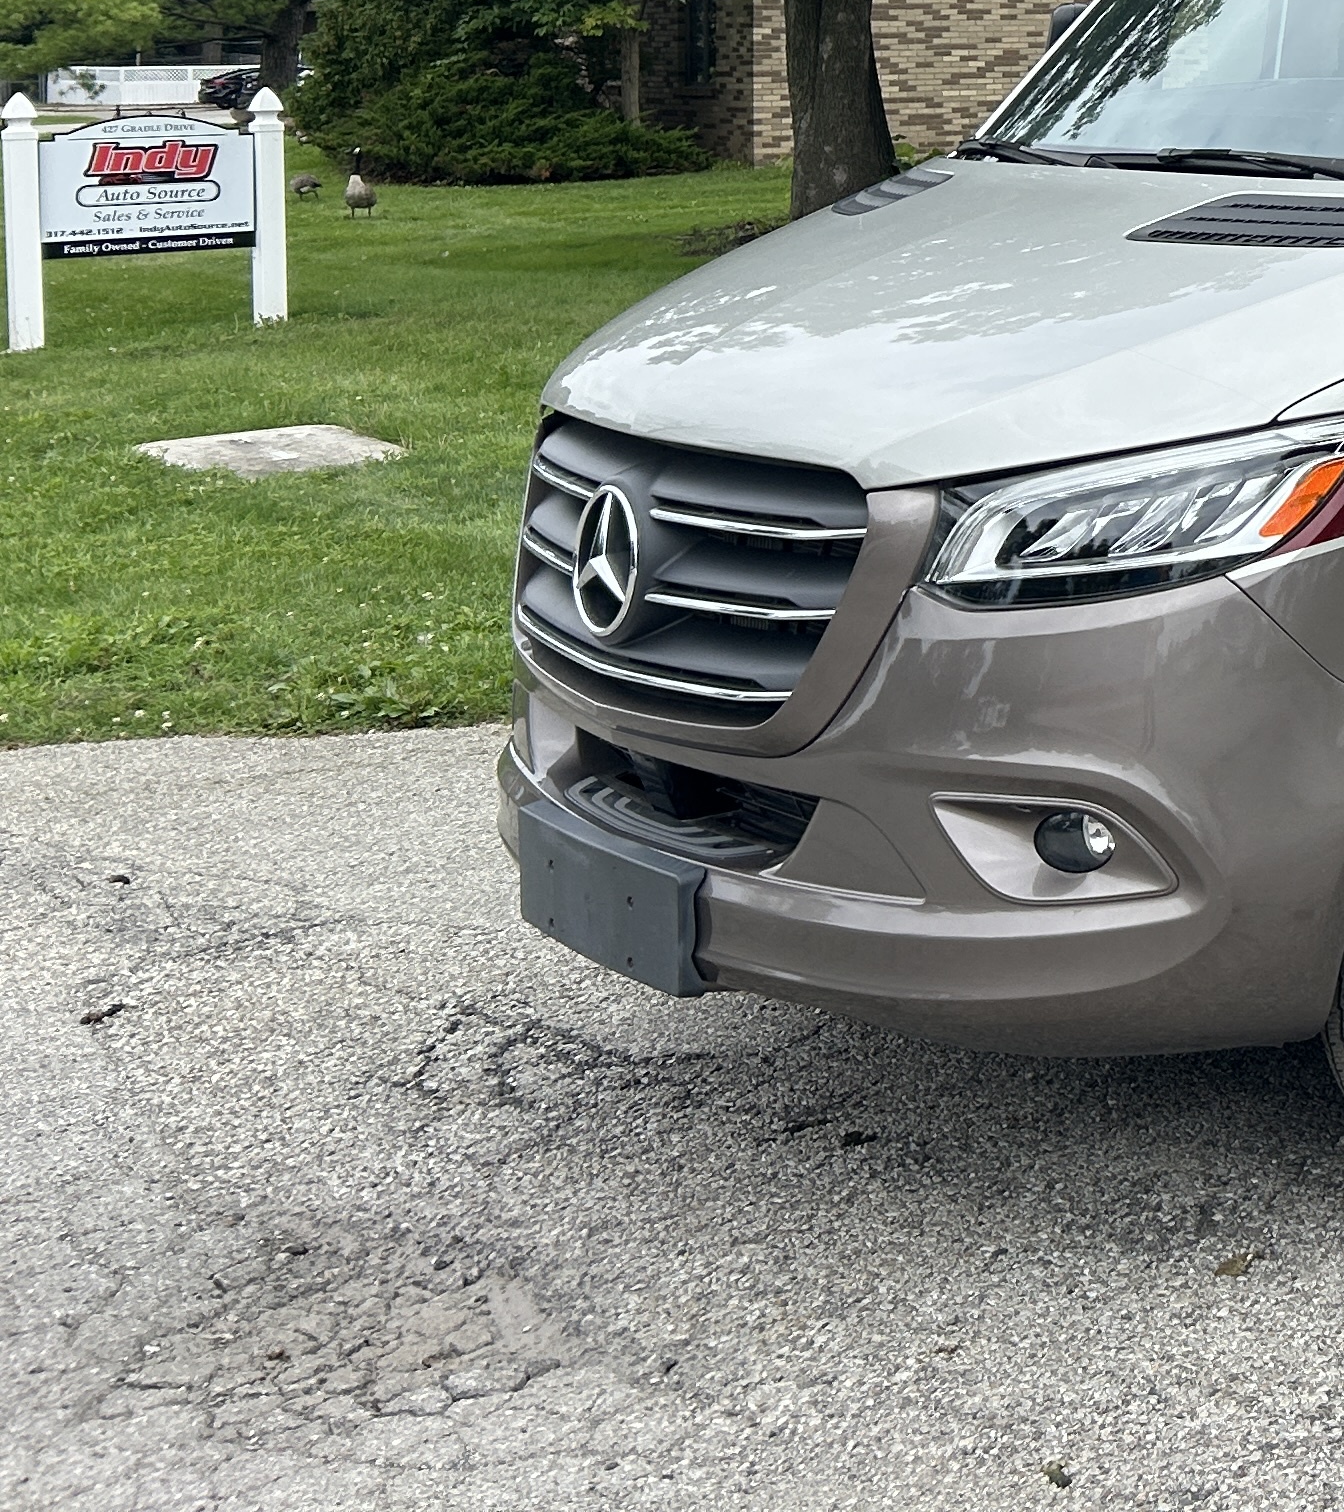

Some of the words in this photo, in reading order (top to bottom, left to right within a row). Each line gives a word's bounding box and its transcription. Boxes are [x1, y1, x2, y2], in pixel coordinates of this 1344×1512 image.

[101, 125, 118, 134] 427
[164, 123, 195, 132] DRIVE
[86, 140, 217, 179] Indy
[96, 189, 140, 202] Auto
[146, 187, 206, 200] Source
[93, 210, 132, 223] Sales
[136, 208, 149, 221] &
[154, 207, 205, 220] Service
[139, 221, 249, 234] IndyAutoSource.net
[63, 243, 100, 255] Family
[102, 241, 140, 252] Owned
[148, 239, 197, 249] Customer
[199, 236, 233, 246] Driven
